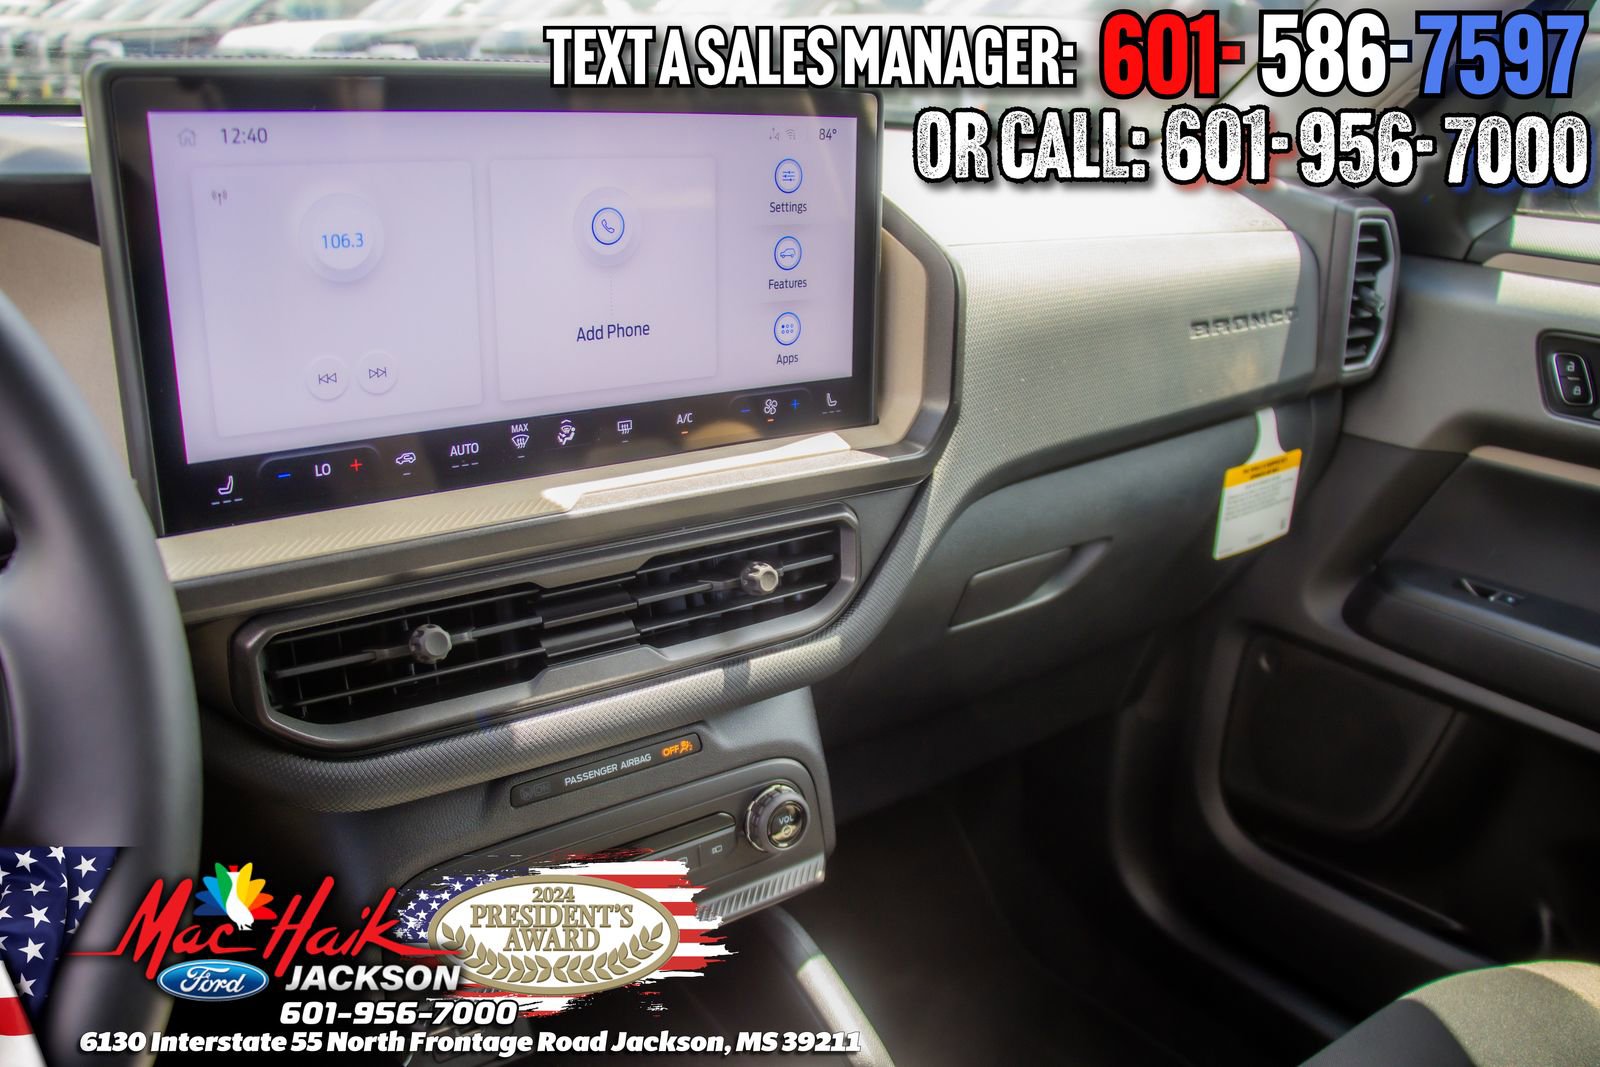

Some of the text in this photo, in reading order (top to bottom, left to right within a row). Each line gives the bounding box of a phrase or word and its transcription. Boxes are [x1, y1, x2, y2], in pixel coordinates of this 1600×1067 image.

[220, 127, 268, 145] 12:40
[769, 201, 808, 214] Settings
[320, 232, 365, 249] 106.3
[768, 278, 807, 290] Features
[576, 322, 650, 342] Add Phone
[776, 353, 799, 365] Apps
[676, 413, 693, 424] A/C
[511, 423, 529, 434] MAX
[450, 442, 479, 457] AUTO
[314, 463, 332, 477] LO
[564, 744, 680, 787] PASSENGER AIRBAG OFF
[778, 815, 794, 825] VOL
